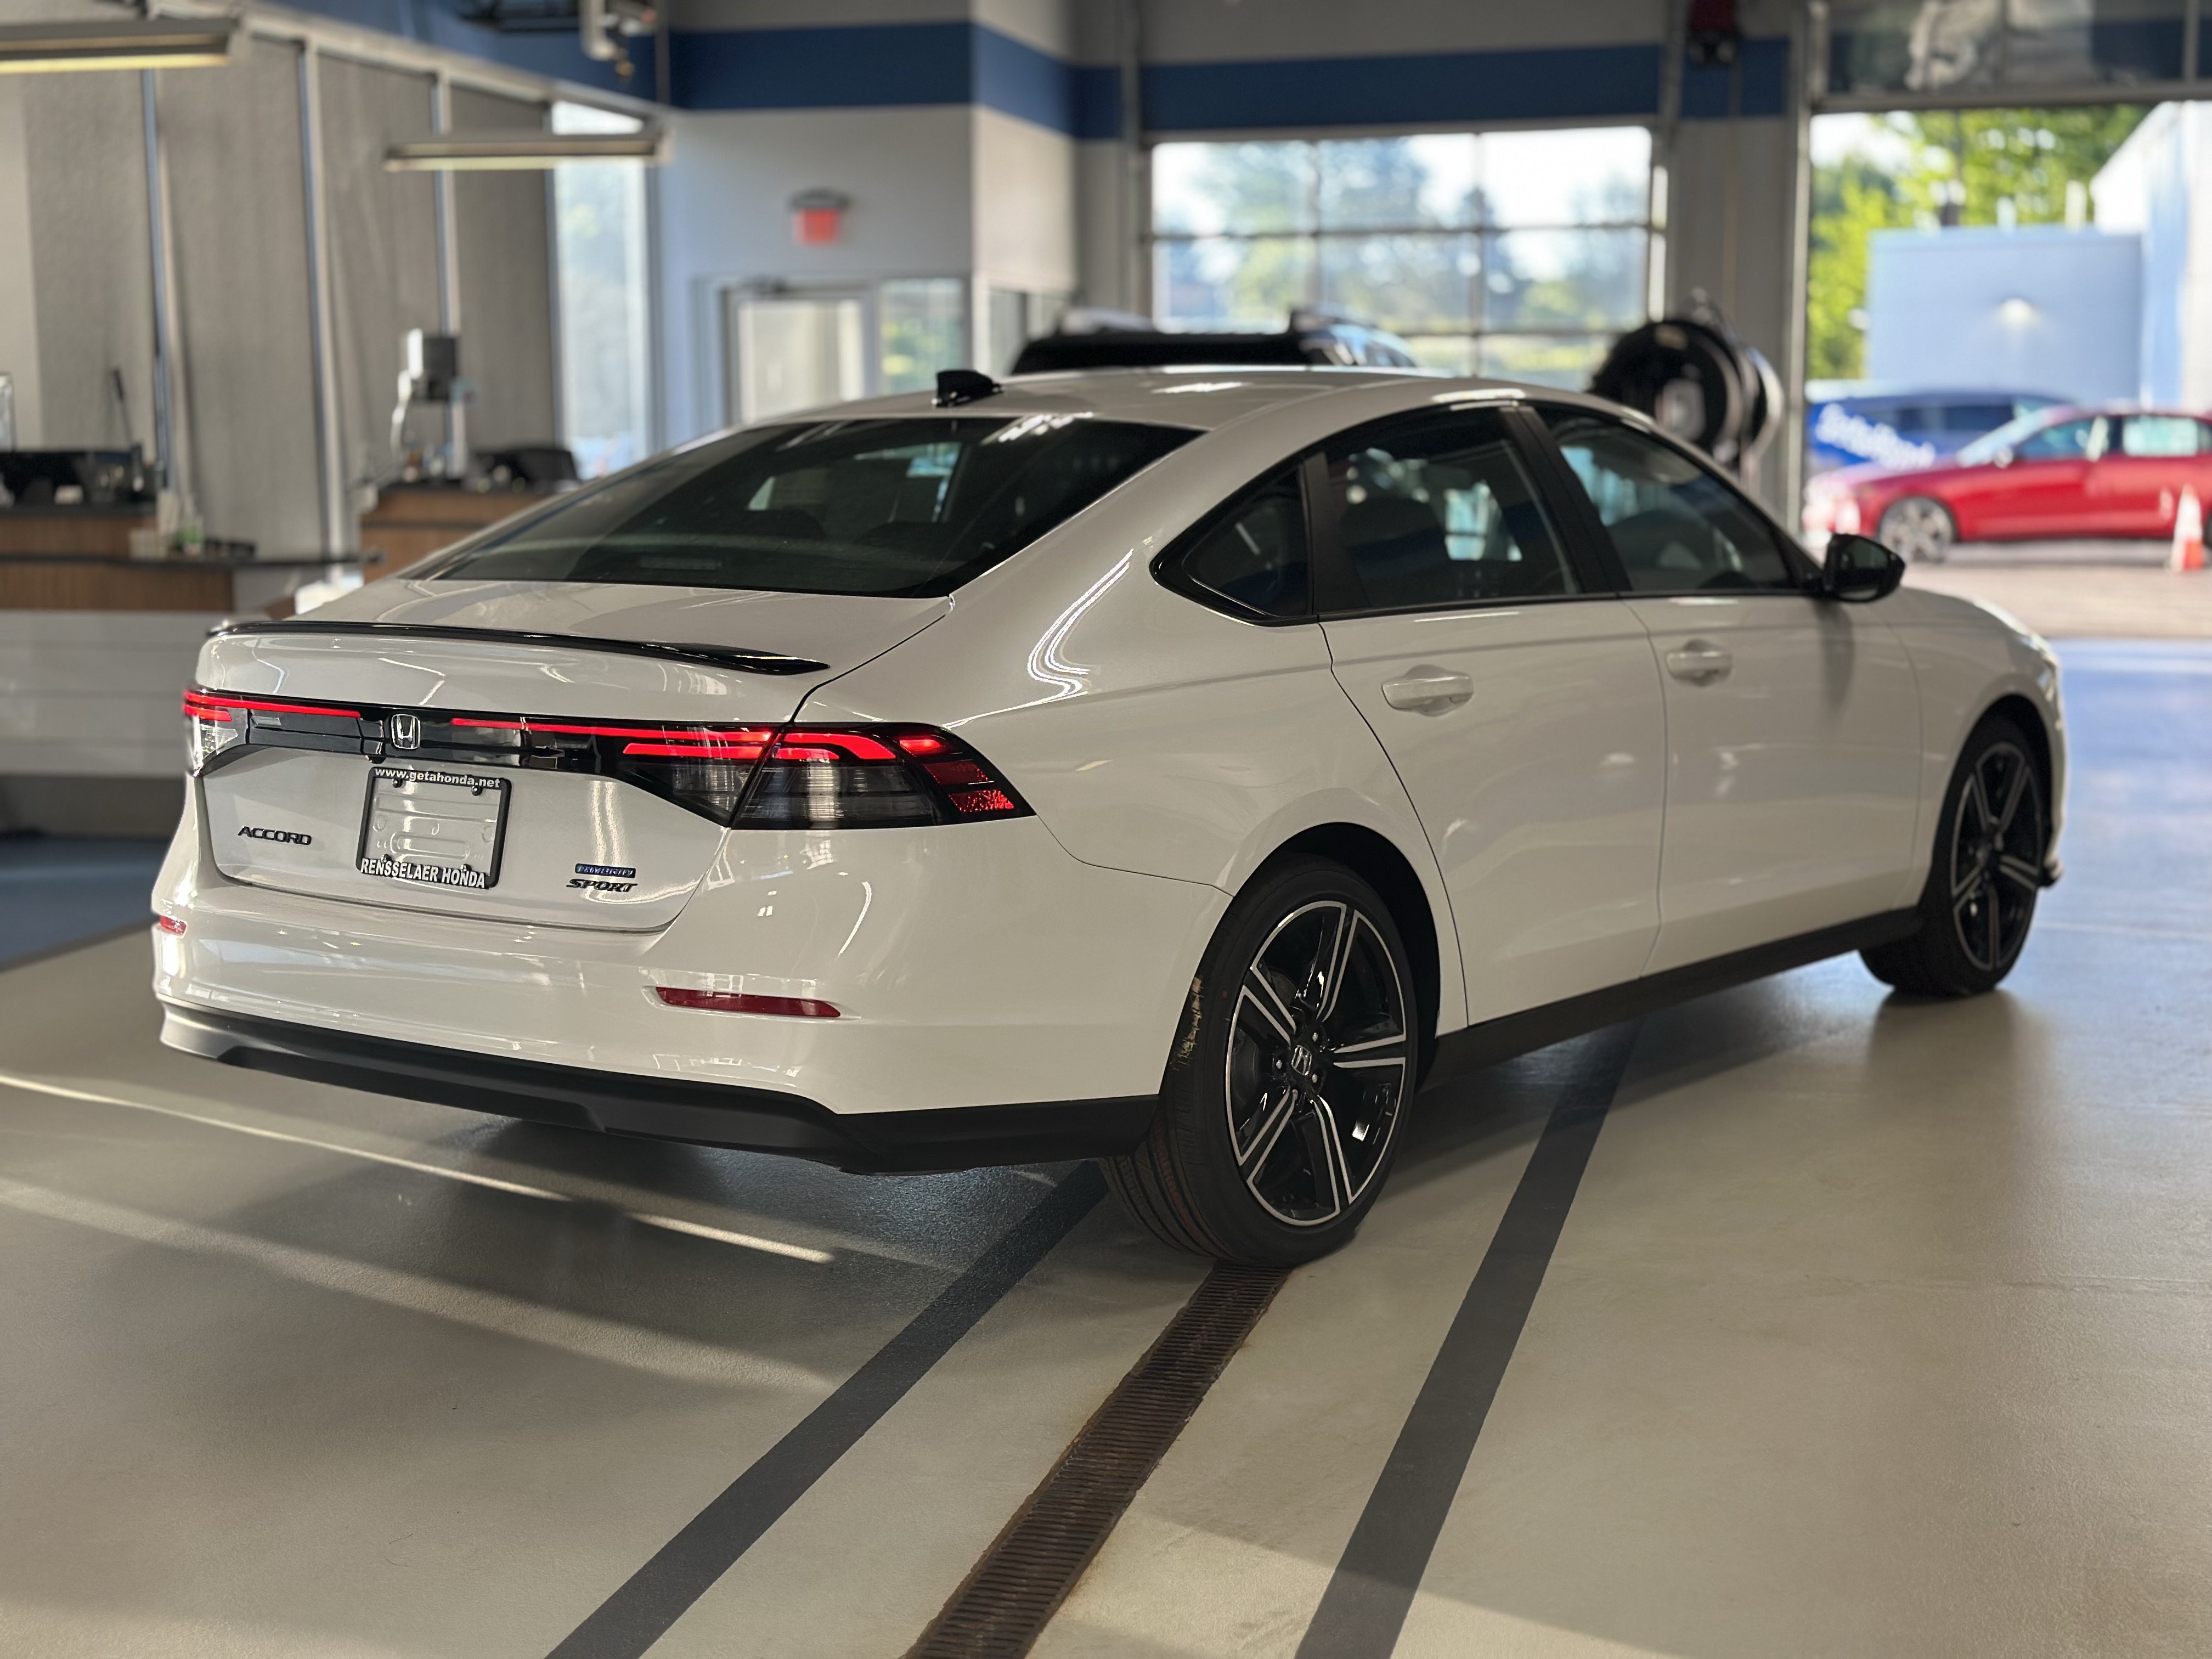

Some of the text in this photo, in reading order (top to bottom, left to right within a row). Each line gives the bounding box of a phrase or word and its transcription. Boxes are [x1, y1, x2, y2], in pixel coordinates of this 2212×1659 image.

[375, 768, 500, 788] www.getahonda.net
[238, 826, 312, 845] ACCORD
[360, 858, 485, 888] RENSSELAER HONDA
[566, 879, 637, 892] SPORT
